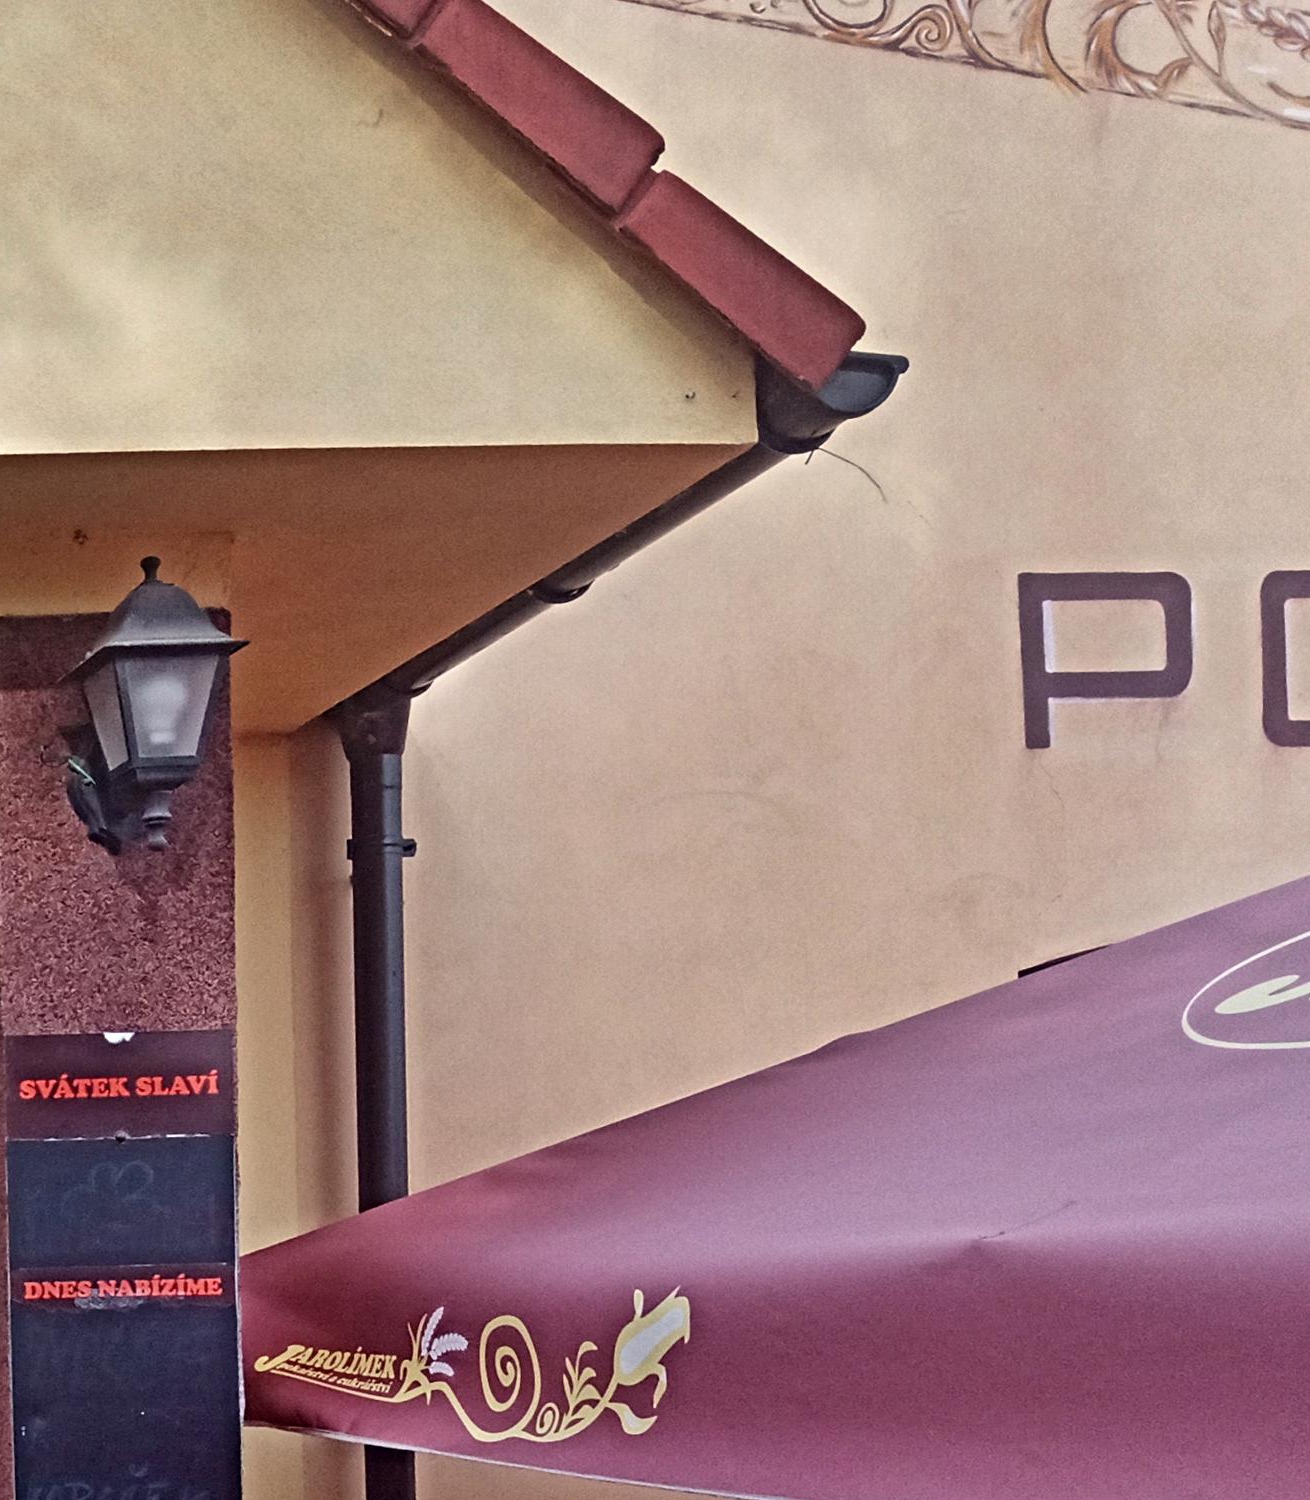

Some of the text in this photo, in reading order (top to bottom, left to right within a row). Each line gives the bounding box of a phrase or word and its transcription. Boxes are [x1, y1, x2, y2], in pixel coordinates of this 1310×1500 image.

[1018, 570, 1310, 749] P
[19, 1069, 219, 1100] SVÁTEK SLAVÍ
[23, 1274, 223, 1301] DNES NABÍZÍME
[254, 1345, 397, 1379] JAROLÍMEK
